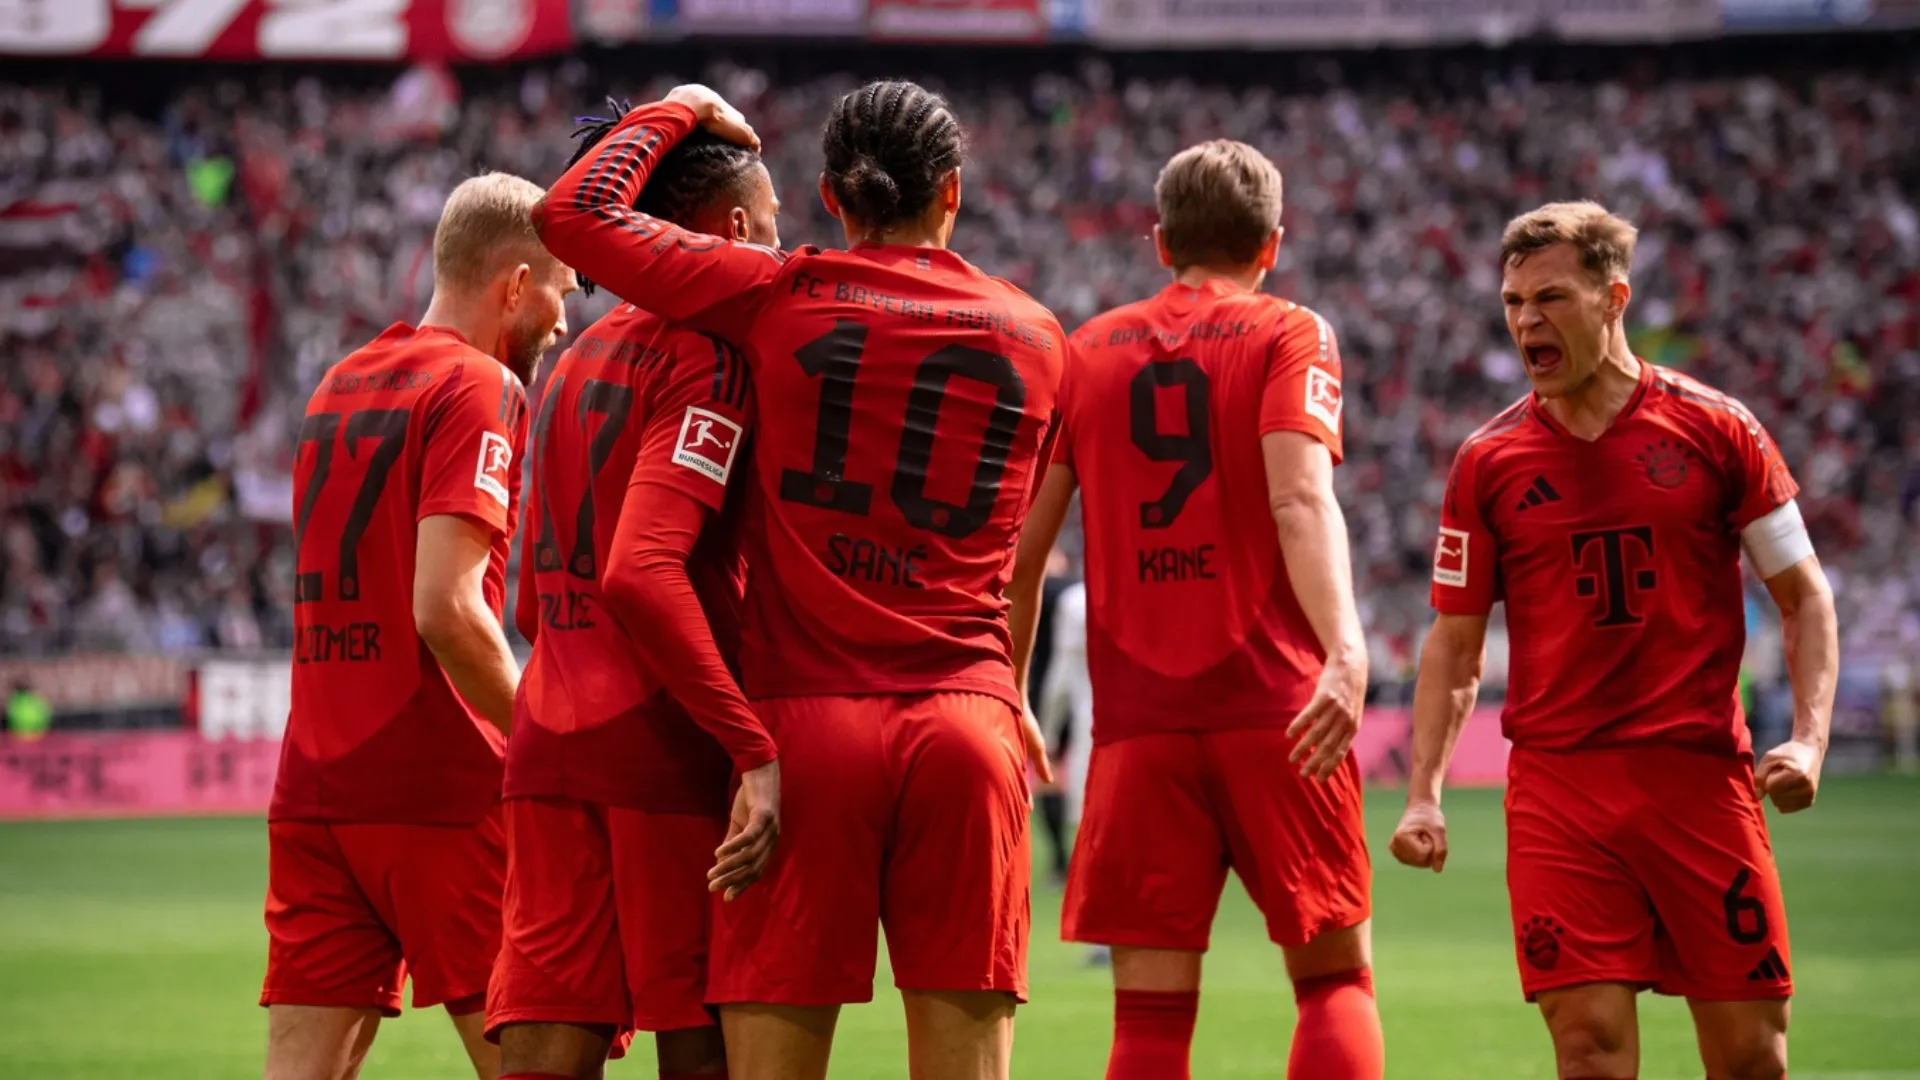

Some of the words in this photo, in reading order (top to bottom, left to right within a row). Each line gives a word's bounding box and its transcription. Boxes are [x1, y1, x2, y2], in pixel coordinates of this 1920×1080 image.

[789, 272, 824, 298] FC
[835, 281, 933, 321] BAYERN
[678, 453, 724, 479] BUNDESLIGA
[781, 320, 1026, 539] 10
[1130, 357, 1213, 529] 9
[1138, 544, 1217, 583] KANE
[1569, 525, 1658, 628] T
[1723, 868, 1769, 945] 6
